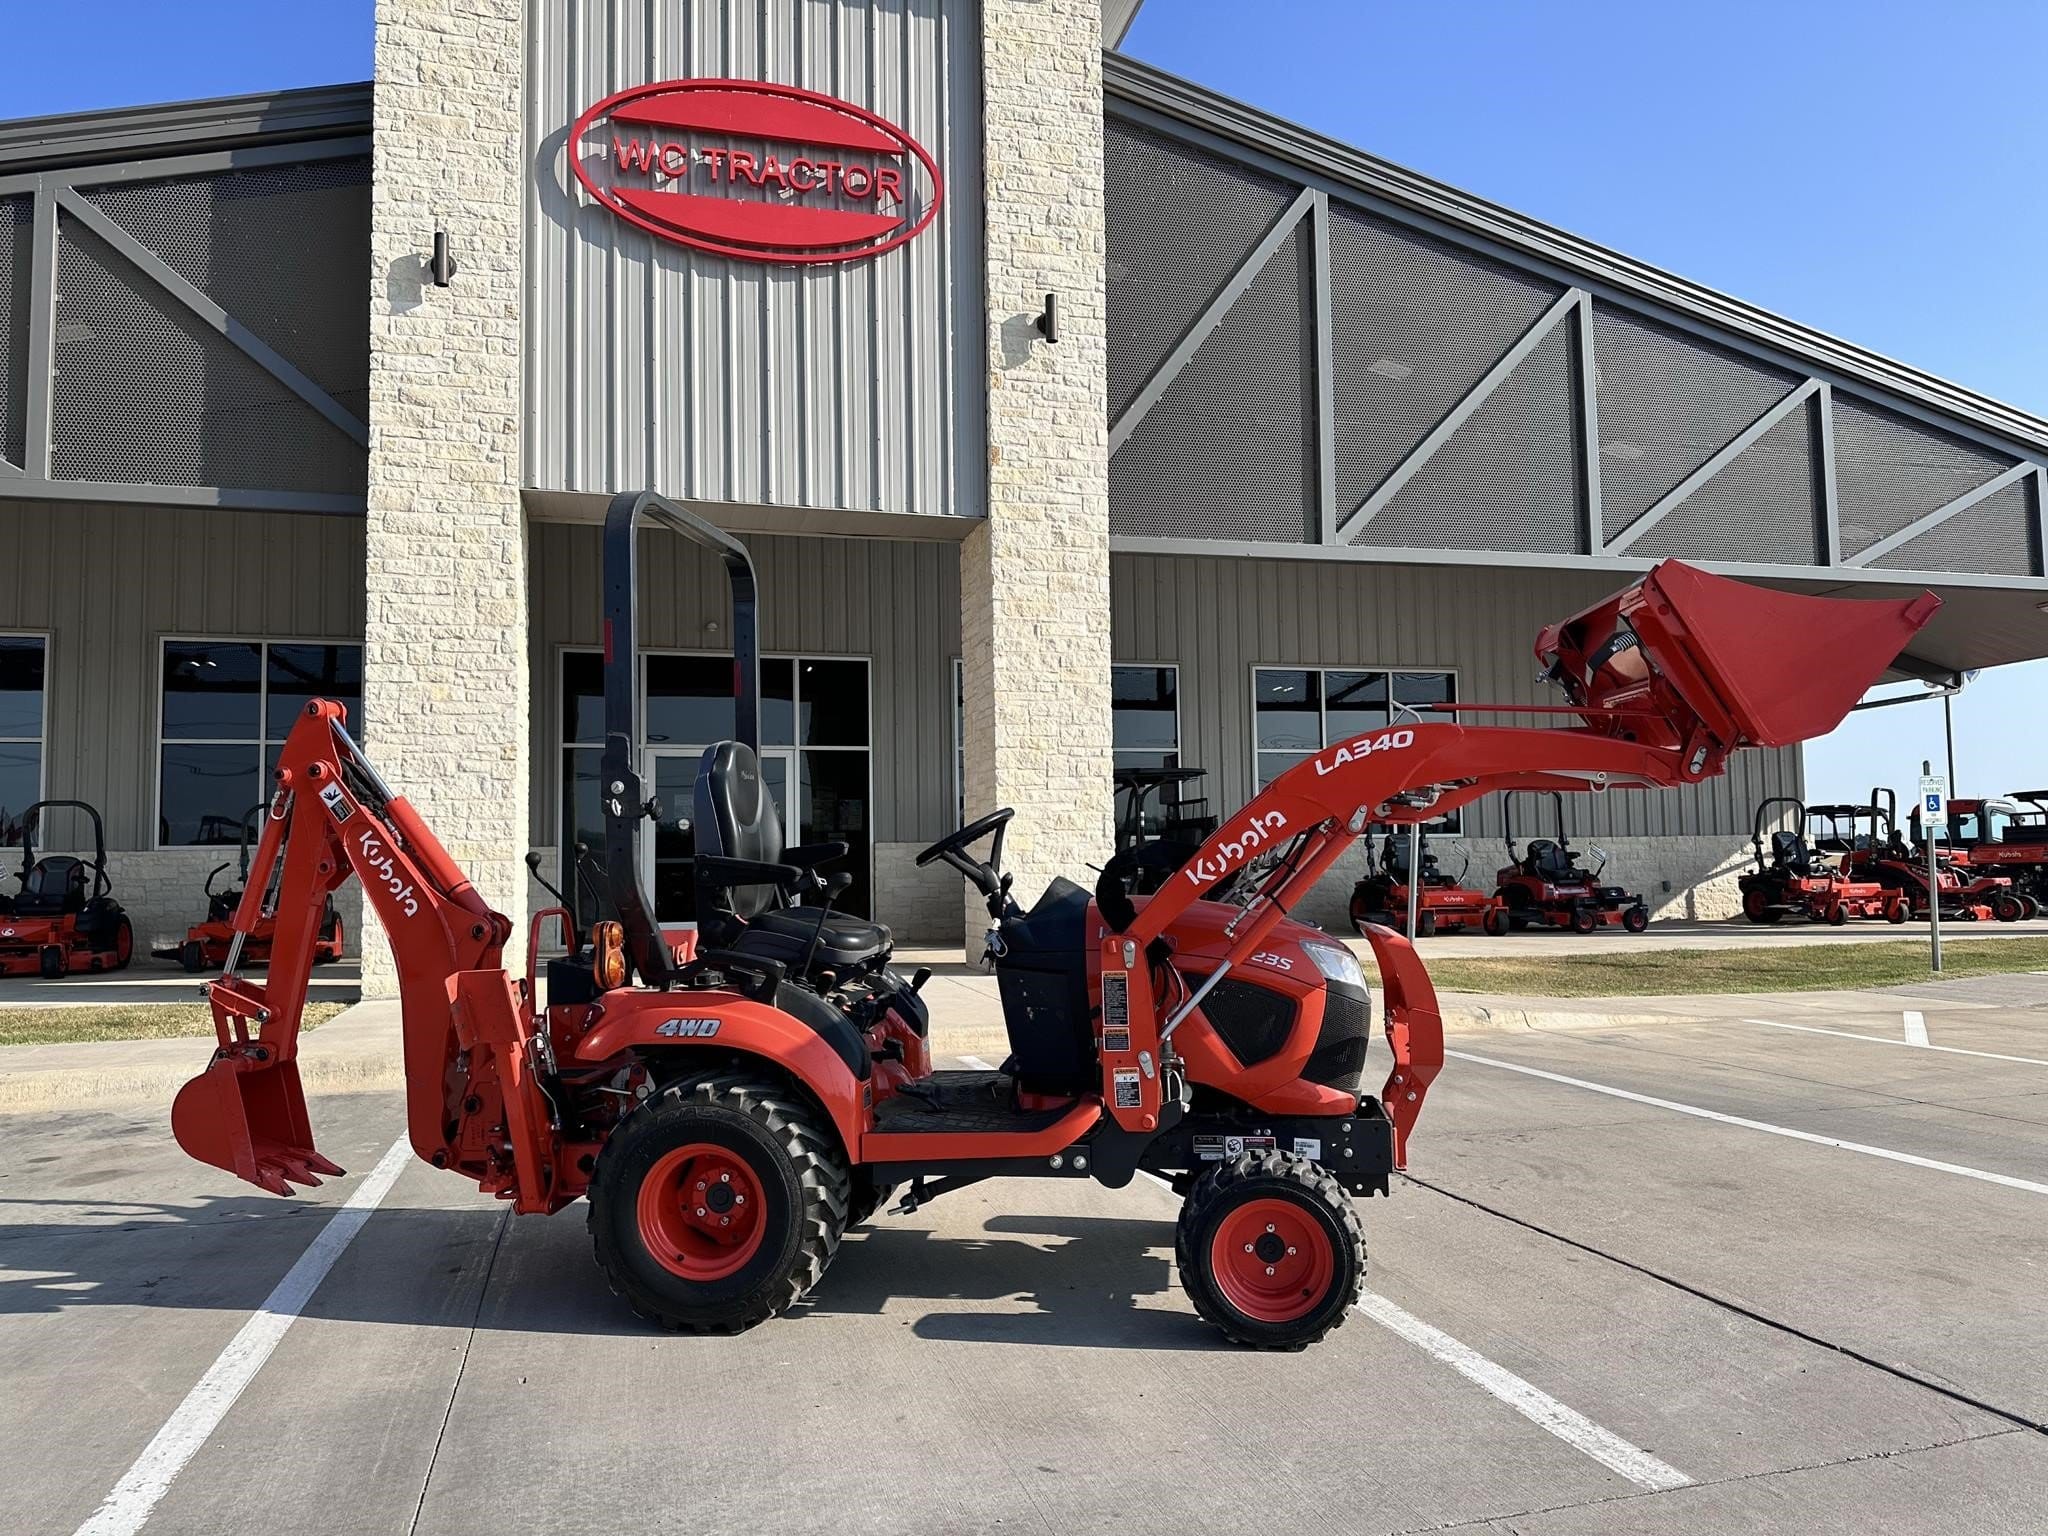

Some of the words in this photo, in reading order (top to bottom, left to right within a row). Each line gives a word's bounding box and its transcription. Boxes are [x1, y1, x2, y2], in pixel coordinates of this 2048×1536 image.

[612, 135, 687, 179] WC
[700, 146, 904, 204] TRACTOR
[1315, 730, 1414, 776] LA340
[360, 830, 418, 917] Kubota
[1185, 810, 1287, 886] Kubota
[1251, 952, 1294, 971] 23S
[655, 1018, 721, 1037] 4WD
